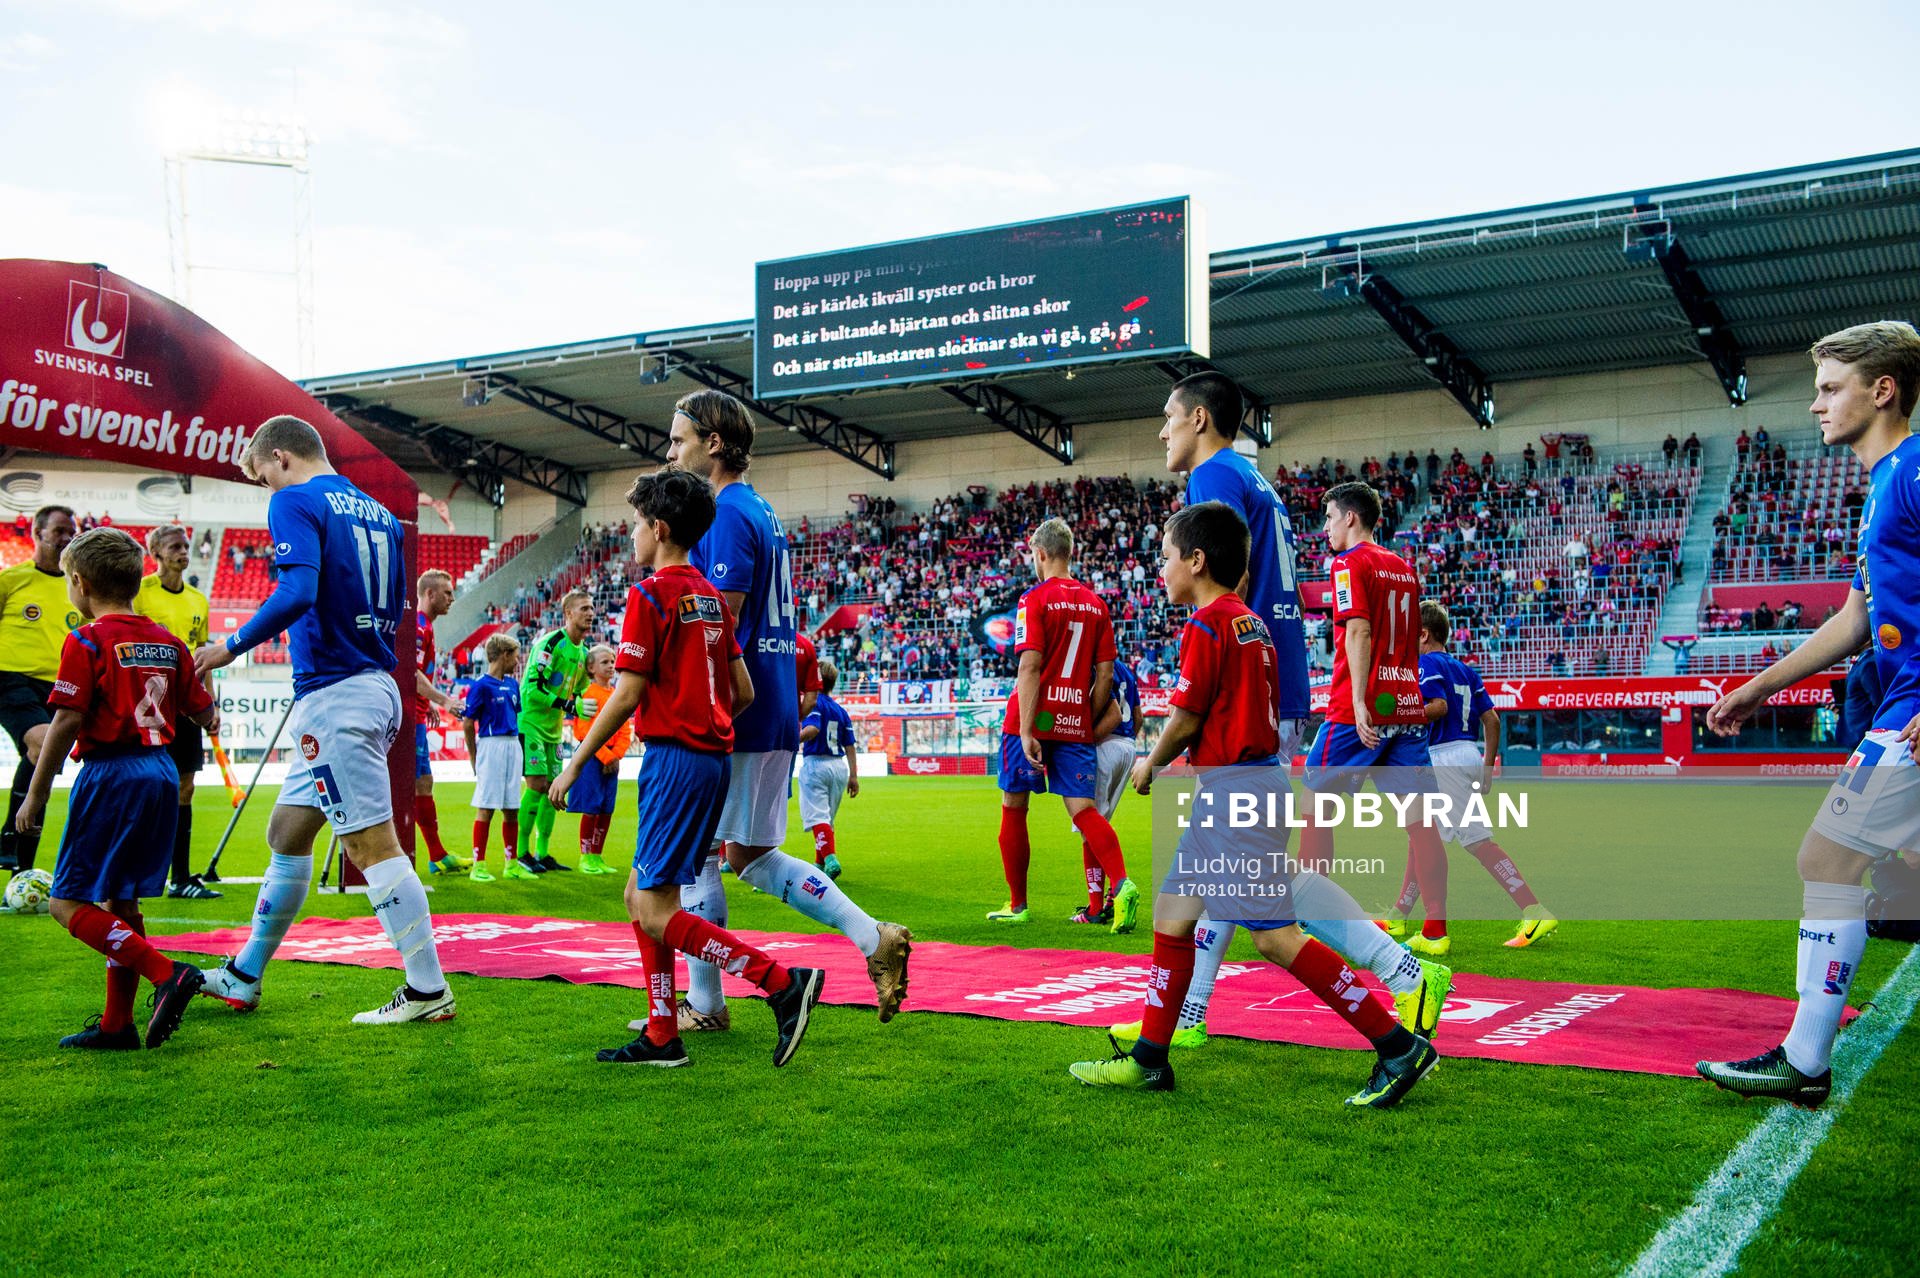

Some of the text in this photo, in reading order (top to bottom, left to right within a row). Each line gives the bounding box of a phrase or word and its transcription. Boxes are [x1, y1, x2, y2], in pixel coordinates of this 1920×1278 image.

[773, 273, 1037, 320] Det är kärlek ikväll syster och bror
[774, 275, 820, 292] Hoppa
[823, 271, 850, 287] upp
[773, 297, 1071, 348] Det är bultande hjärtan och slitna skor
[773, 358, 802, 377] Och
[804, 357, 832, 374] när
[832, 346, 936, 370] strålkastaren
[937, 337, 1008, 359] slocknar
[1008, 332, 1038, 349] ska
[1040, 327, 1057, 345] vi
[1060, 325, 1086, 348] gå,
[34, 348, 154, 387] SVENSKA SPEL
[0, 379, 254, 467] för svensk fotb
[352, 524, 390, 609] 11
[222, 697, 291, 714] esurs
[1047, 685, 1083, 705] LJUNG
[1396, 692, 1420, 706] Solid
[1453, 684, 1473, 732] 7
[220, 717, 266, 738] ank
[1055, 713, 1082, 727] Solid
[650, 972, 660, 998] INTER
